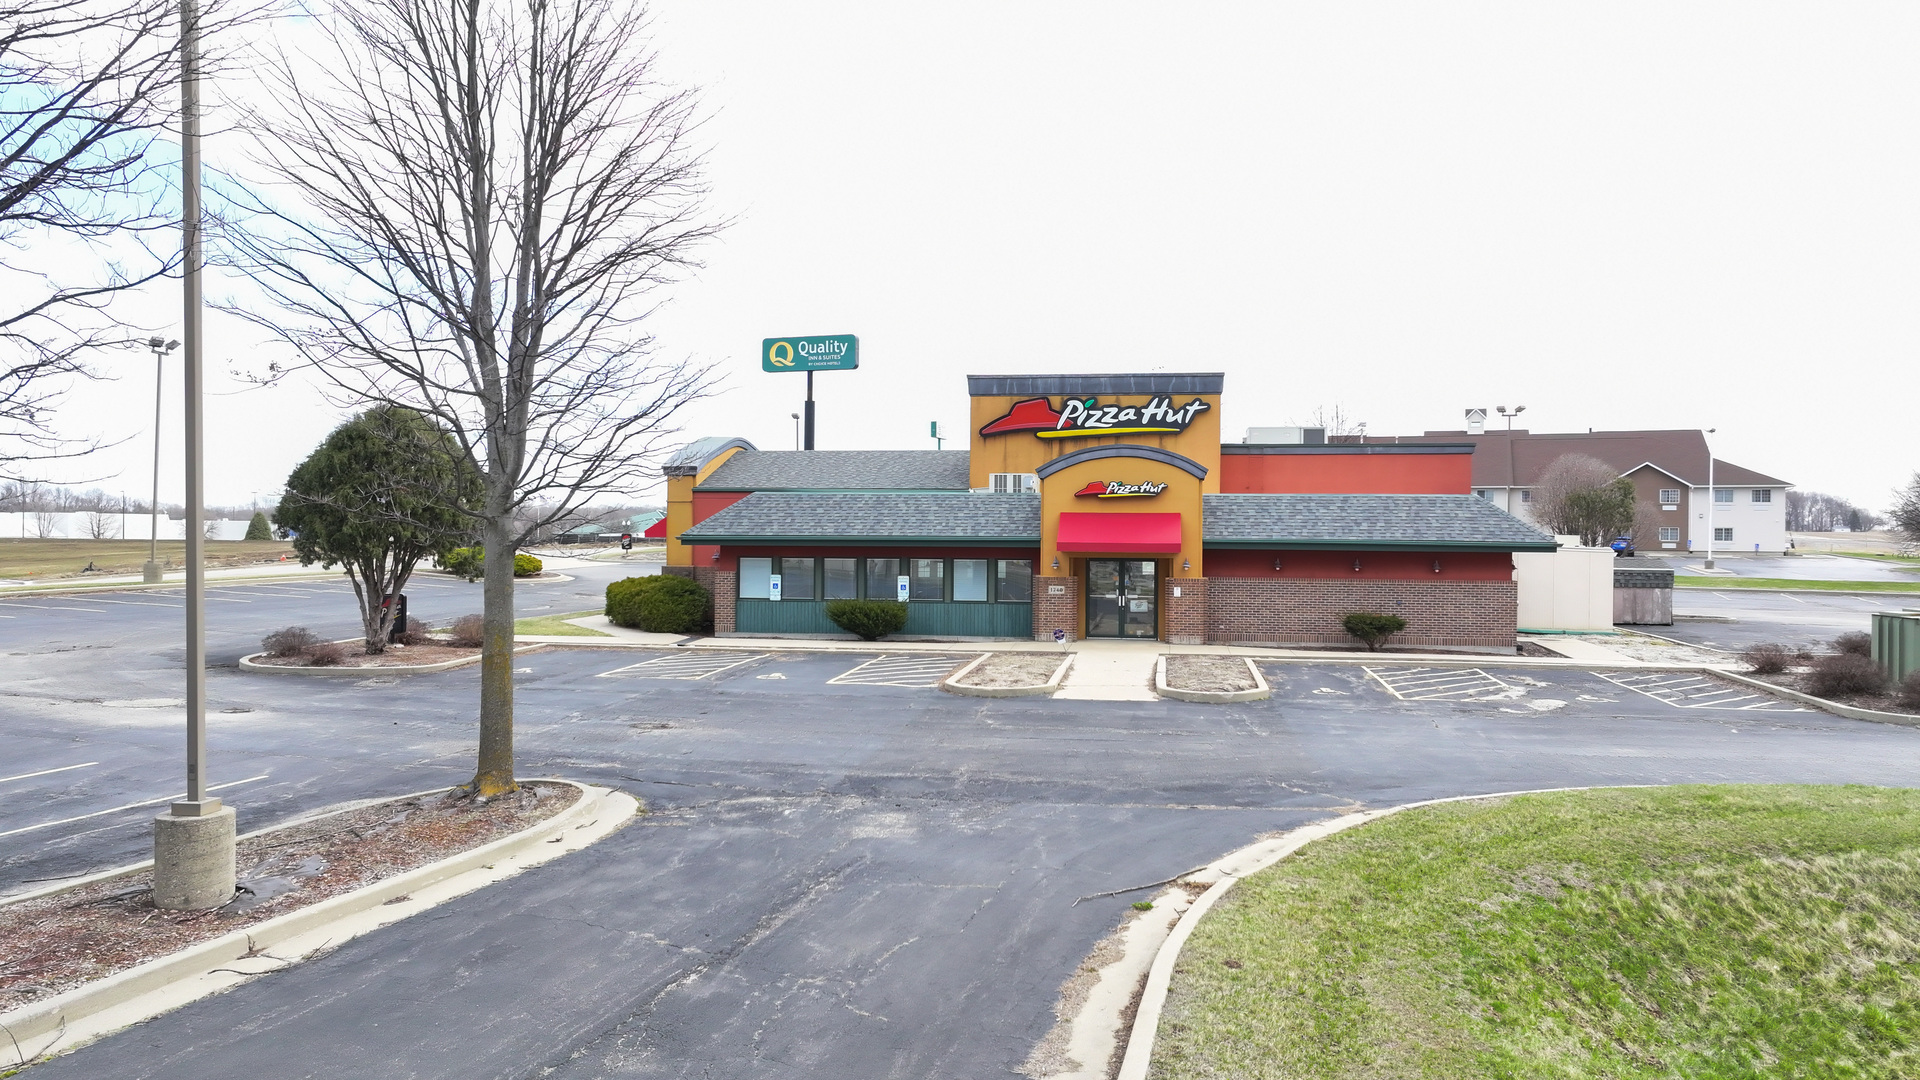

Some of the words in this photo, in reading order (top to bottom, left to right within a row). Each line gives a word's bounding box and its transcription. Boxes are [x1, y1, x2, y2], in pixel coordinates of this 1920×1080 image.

[798, 340, 848, 356] Quality
[1057, 398, 1138, 430] Pizza
[1141, 396, 1208, 425] Hut
[1106, 481, 1139, 495] Pizza
[1140, 481, 1168, 493] Hut
